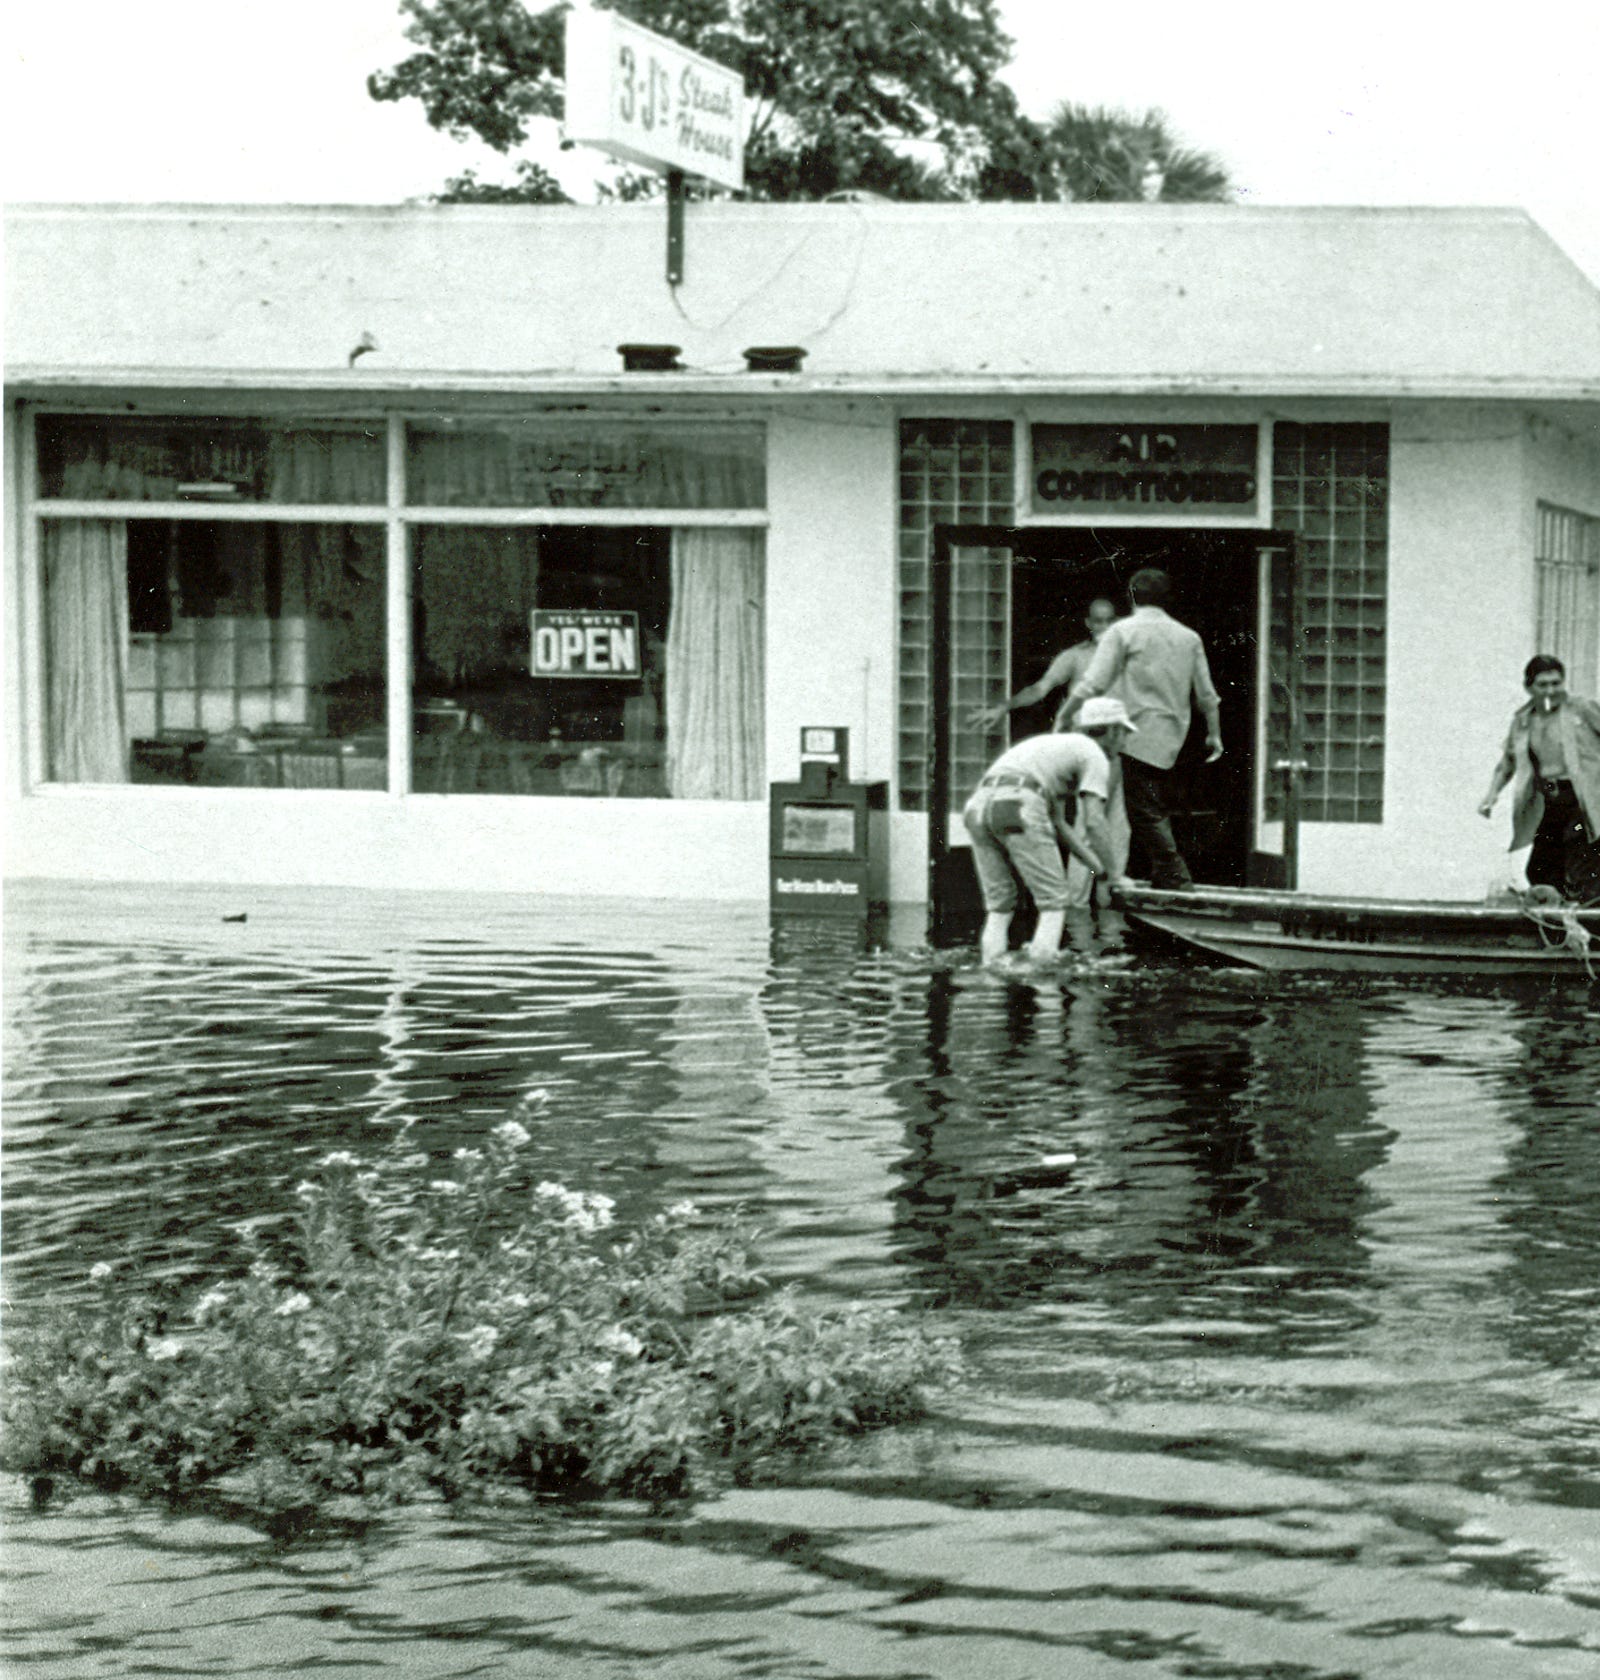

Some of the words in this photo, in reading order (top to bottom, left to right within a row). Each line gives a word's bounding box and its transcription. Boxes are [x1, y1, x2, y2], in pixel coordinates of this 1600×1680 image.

[677, 65, 733, 121] Steak
[675, 112, 733, 161] House
[1114, 432, 1178, 462] AIR
[1037, 468, 1256, 503] CONDITIONED
[537, 627, 635, 671] OPEN
